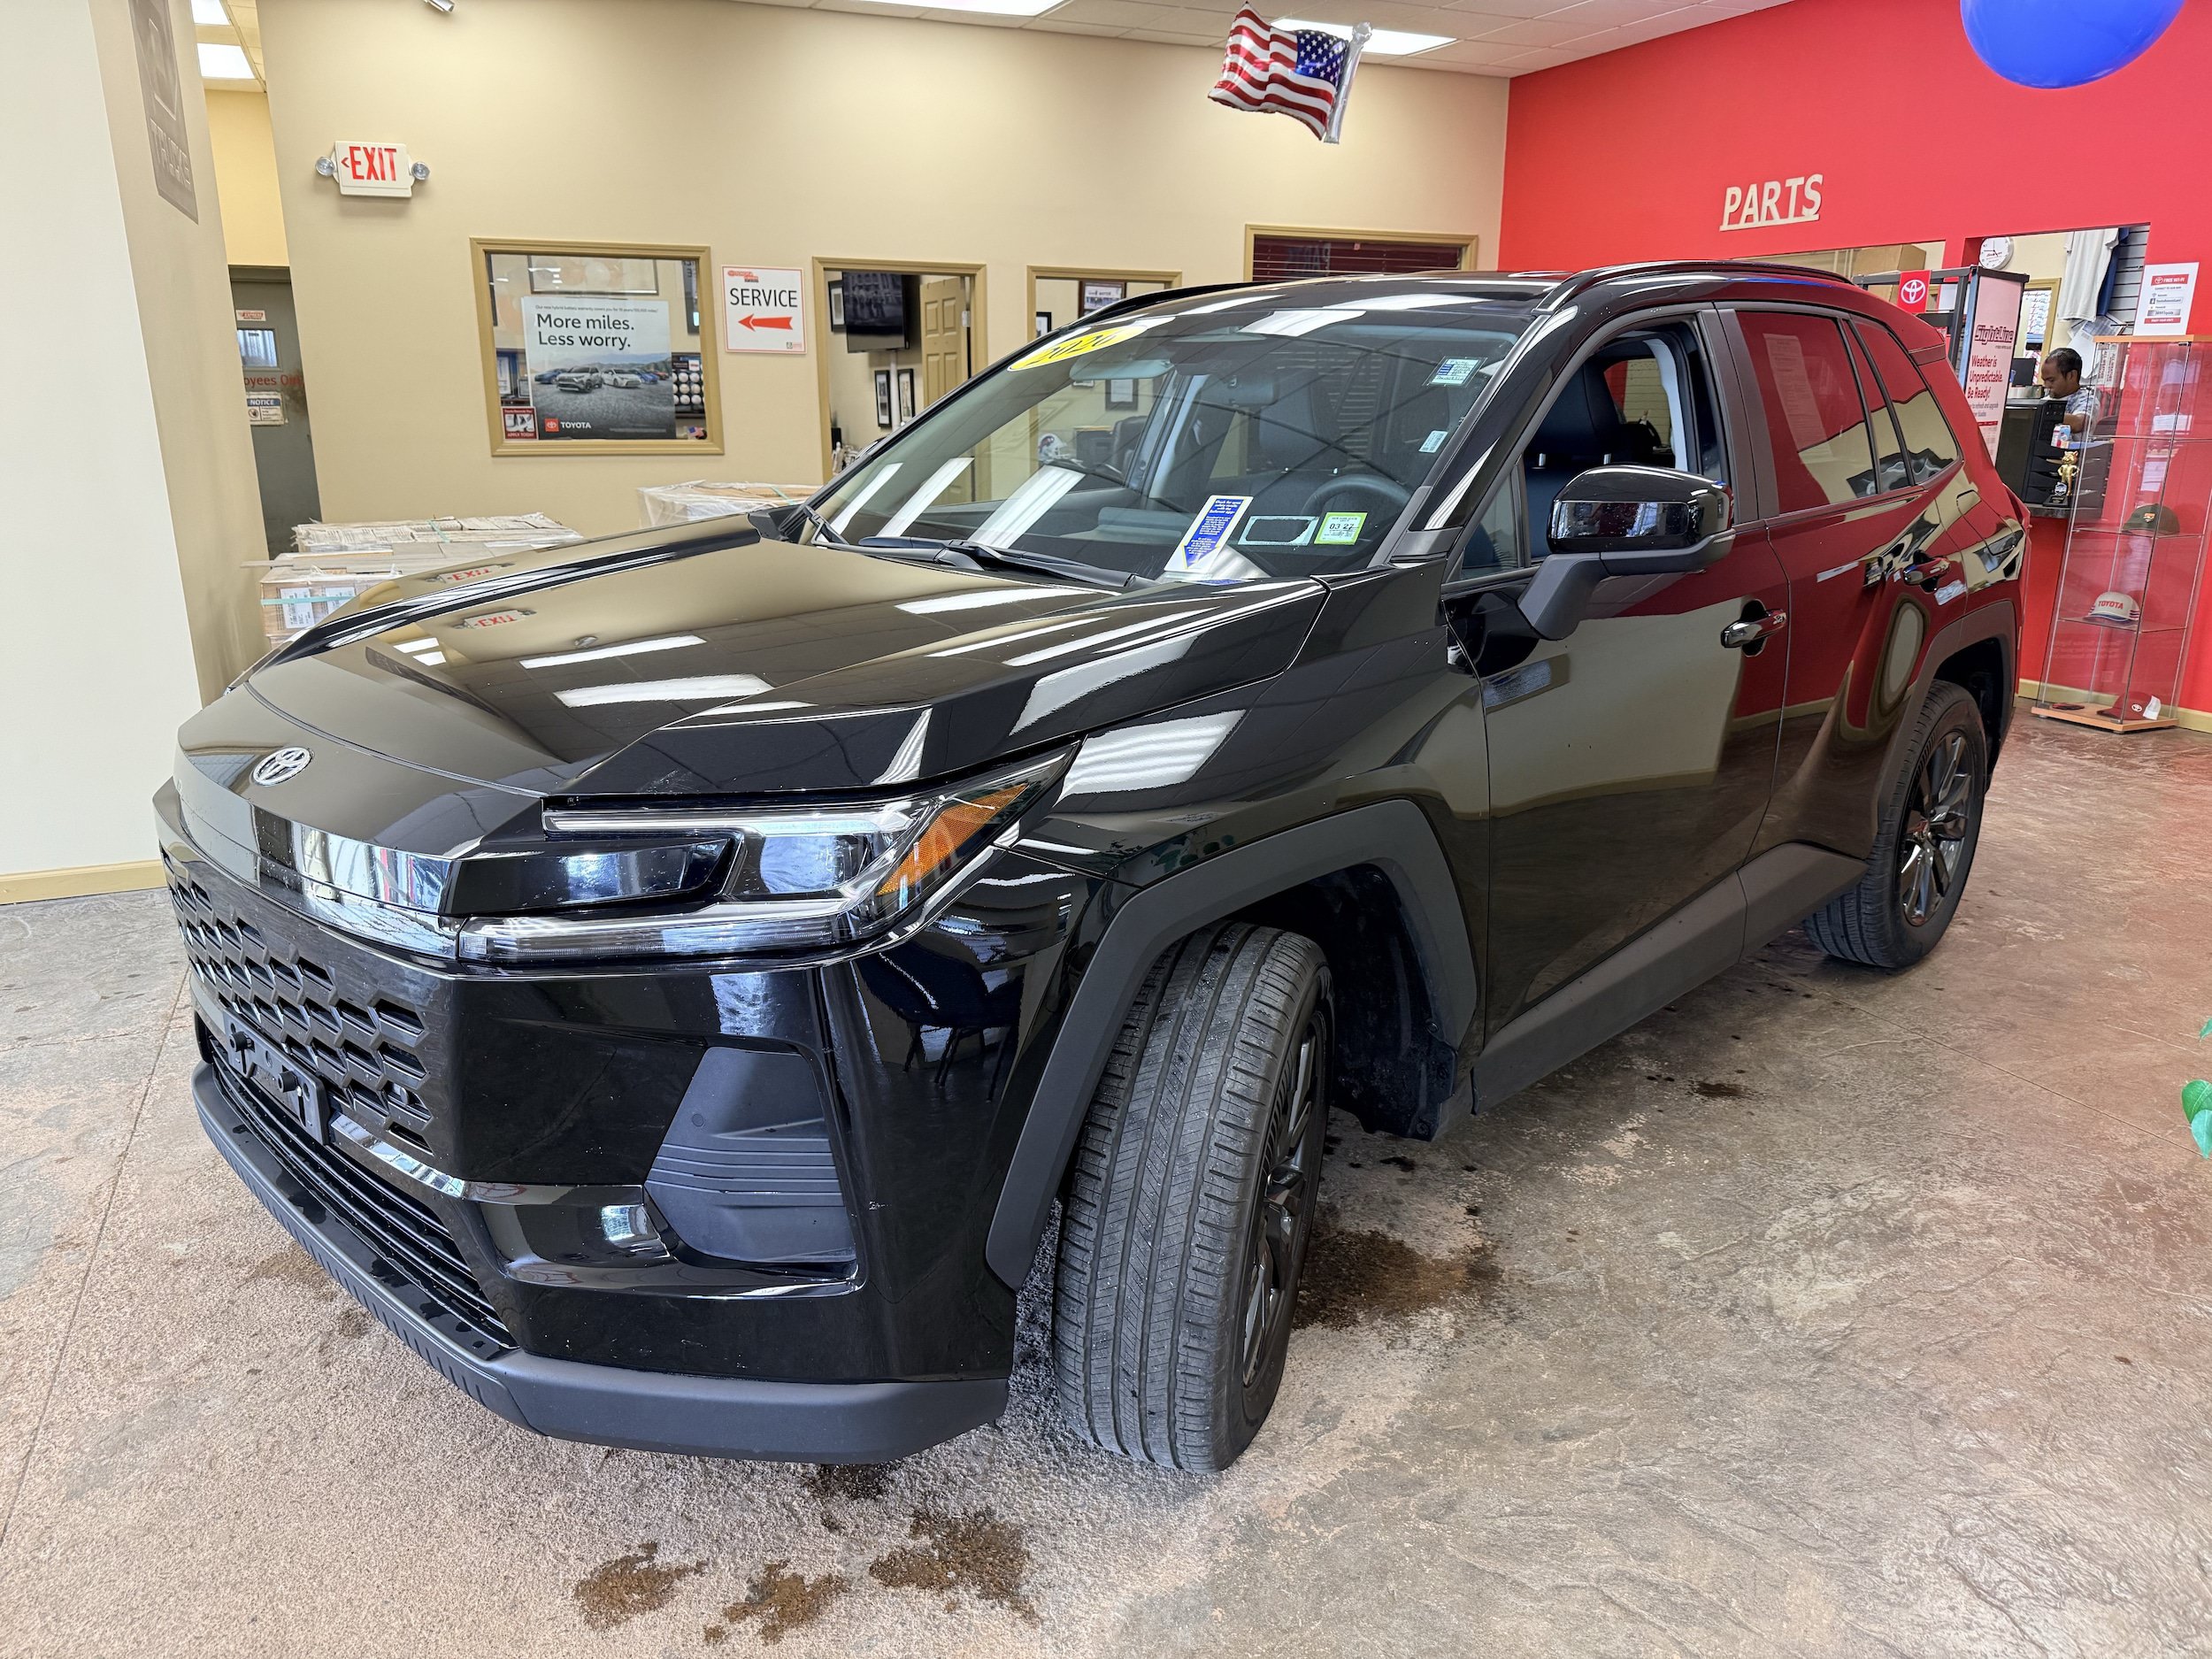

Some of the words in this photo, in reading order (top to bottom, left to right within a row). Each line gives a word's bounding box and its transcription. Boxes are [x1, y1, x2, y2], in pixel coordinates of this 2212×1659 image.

[349, 146, 396, 181] EXIT
[1722, 173, 1824, 229] PARTS
[730, 288, 798, 308] SERVICE
[537, 313, 581, 329] More
[586, 315, 634, 330] miles.
[539, 331, 574, 346] Less
[579, 335, 631, 350] worry.
[1974, 325, 2014, 345] SightLine
[1971, 355, 1993, 367] Weather
[1993, 356, 1997, 367] is
[244, 377, 277, 388] oyees
[1970, 370, 2003, 386] Unpredictable.
[1968, 387, 1974, 398] Be
[1974, 386, 1992, 401] Ready!
[2099, 601, 2124, 610] TOYOTA
